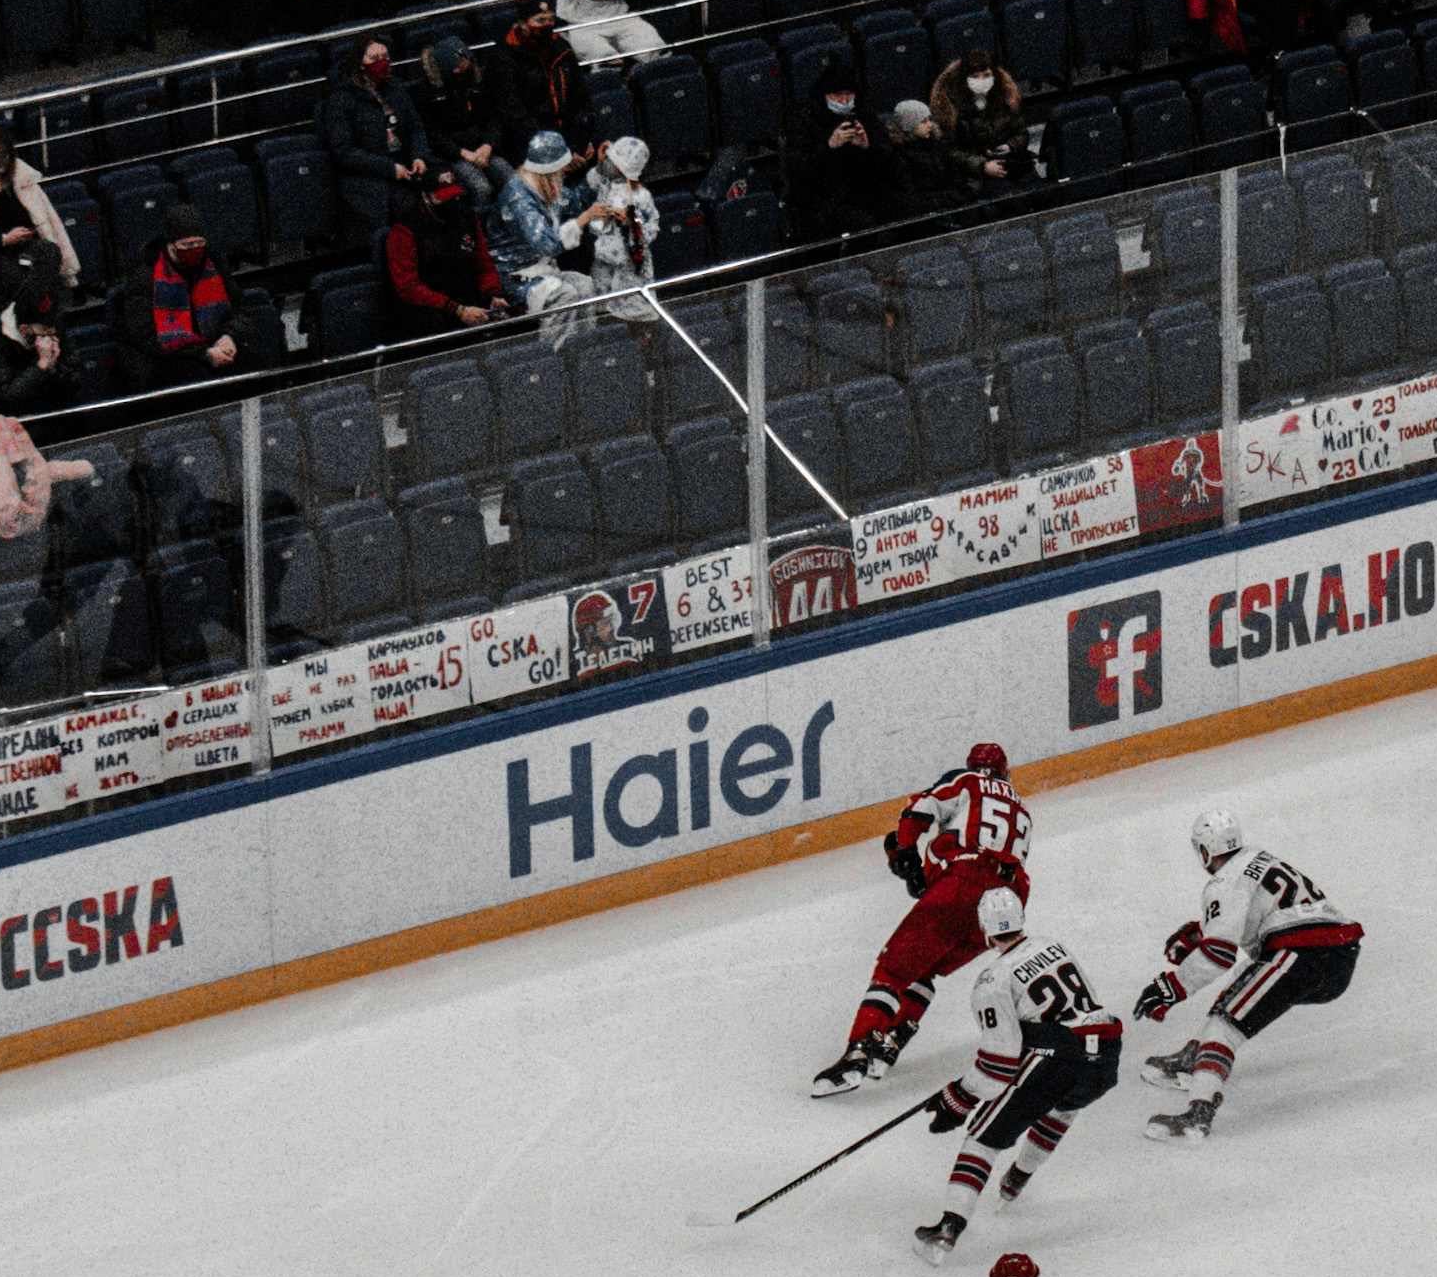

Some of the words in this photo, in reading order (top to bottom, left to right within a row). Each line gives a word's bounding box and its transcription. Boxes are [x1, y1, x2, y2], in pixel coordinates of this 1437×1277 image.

[1372, 396, 1396, 417] 23
[1332, 458, 1356, 481] 23
[959, 485, 1018, 511] МАМИН
[1052, 480, 1117, 510] ЗАЩИЩАЕТ
[876, 530, 917, 554] АНТОН
[931, 517, 944, 541] 9
[979, 514, 999, 538] 98
[1043, 510, 1079, 535] ЦСКА
[1044, 537, 1058, 553] НЕ
[1070, 516, 1136, 545] ПРОПУСКАЕТ
[686, 556, 732, 588] BEST
[628, 579, 657, 624] 7
[677, 592, 691, 617] 6
[708, 586, 726, 613] &
[789, 575, 832, 623] 44
[670, 611, 751, 646] DEFENSEME
[368, 629, 446, 661] КАРНАУХОВ
[305, 659, 328, 677] МЫ
[371, 674, 439, 702] ГОРДОСТЬ
[437, 645, 462, 690] 15
[529, 647, 561, 684] GO!
[310, 683, 322, 695] НЕ
[337, 674, 356, 688] РАЗ
[183, 702, 238, 724] СЕРДЦАХ
[321, 697, 354, 715] КУБОК
[98, 720, 159, 748] КОТОРОЙ
[299, 722, 345, 743] РУКАМИ
[95, 752, 128, 771] НАМ
[195, 746, 238, 766] ЦВЕТА
[65, 784, 79, 800] НЕ
[506, 700, 835, 879] Haier
[979, 779, 1020, 803] MAXI
[979, 796, 1032, 860] 52
[1014, 943, 1067, 984] CHIVILEV
[1028, 962, 1103, 1023] 28
